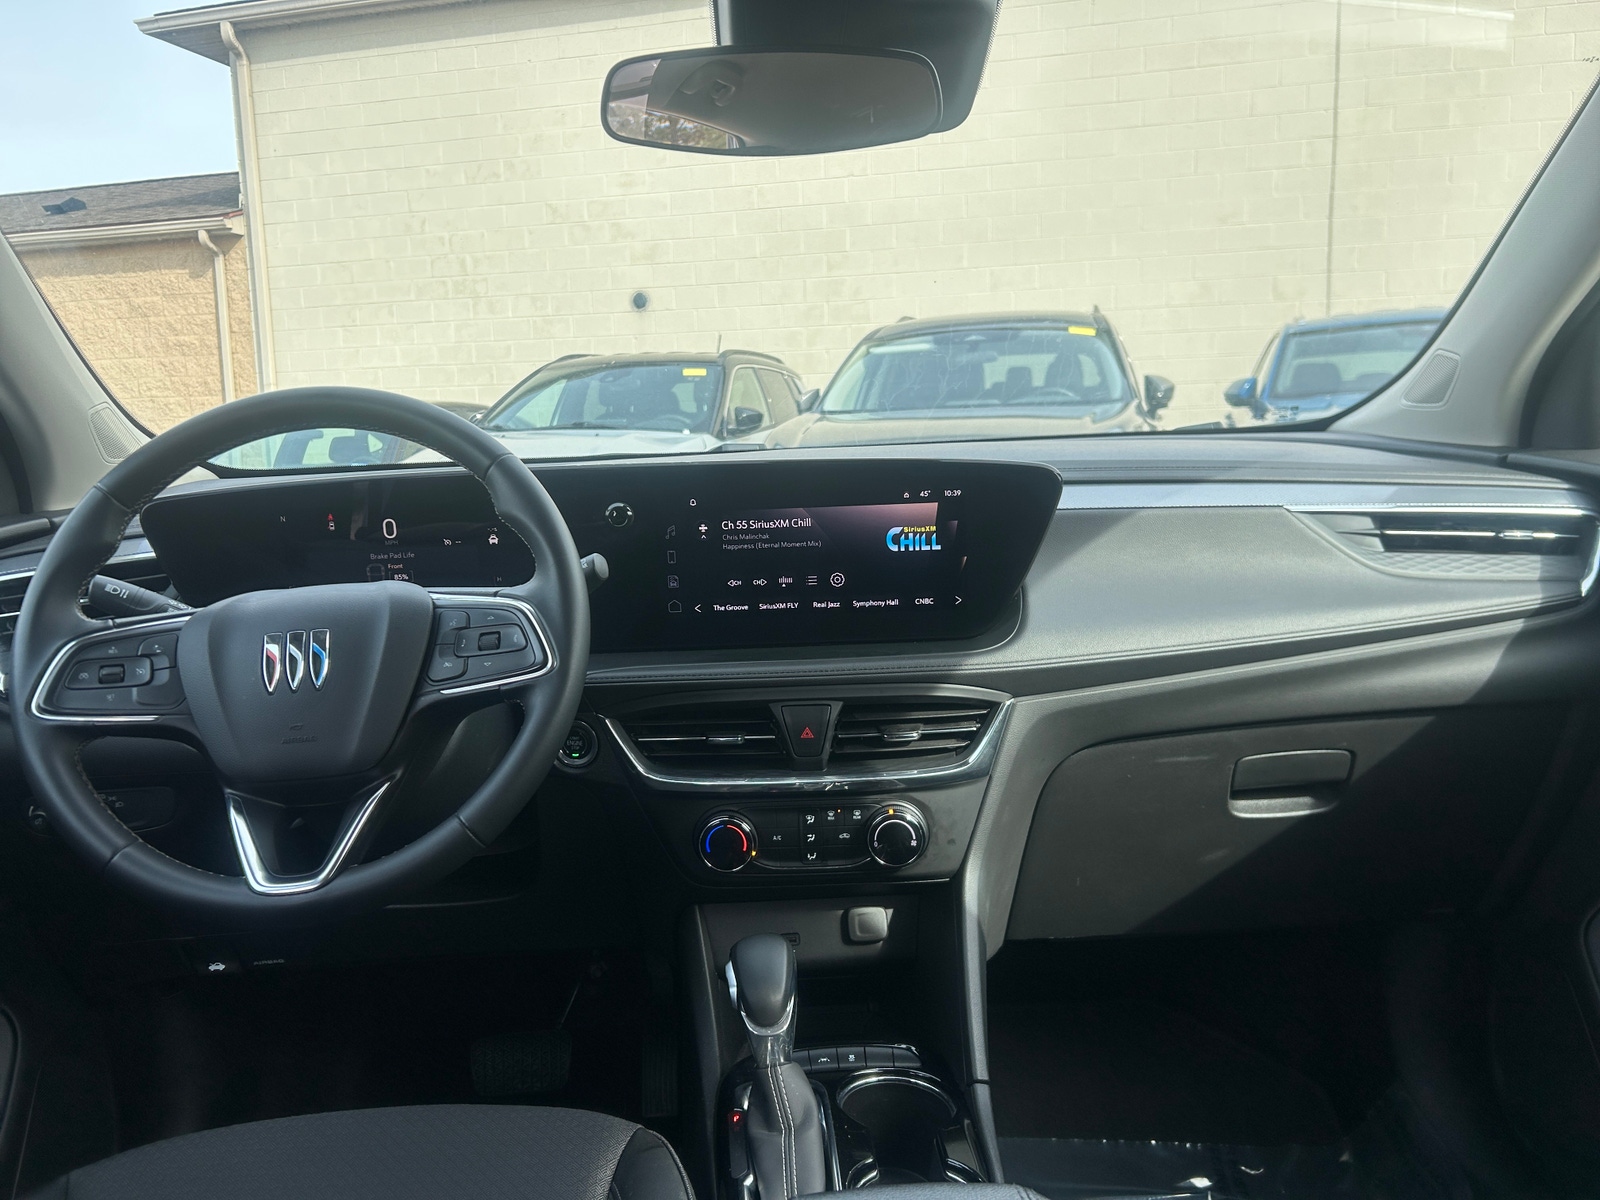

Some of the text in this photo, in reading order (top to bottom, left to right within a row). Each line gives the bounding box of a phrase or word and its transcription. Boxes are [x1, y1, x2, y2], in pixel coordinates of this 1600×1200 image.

[944, 489, 962, 497] 10:39
[382, 518, 397, 539] 0
[721, 518, 812, 530] Ch 55 SiriusXM Chill
[739, 533, 770, 541] Malinchak
[886, 526, 941, 552] CHILL
[722, 543, 755, 551] Happiness
[755, 542, 780, 550] (Eternal
[808, 540, 822, 548] Mix)
[759, 602, 786, 610] SiriusXM
[852, 599, 885, 608] Symphony
